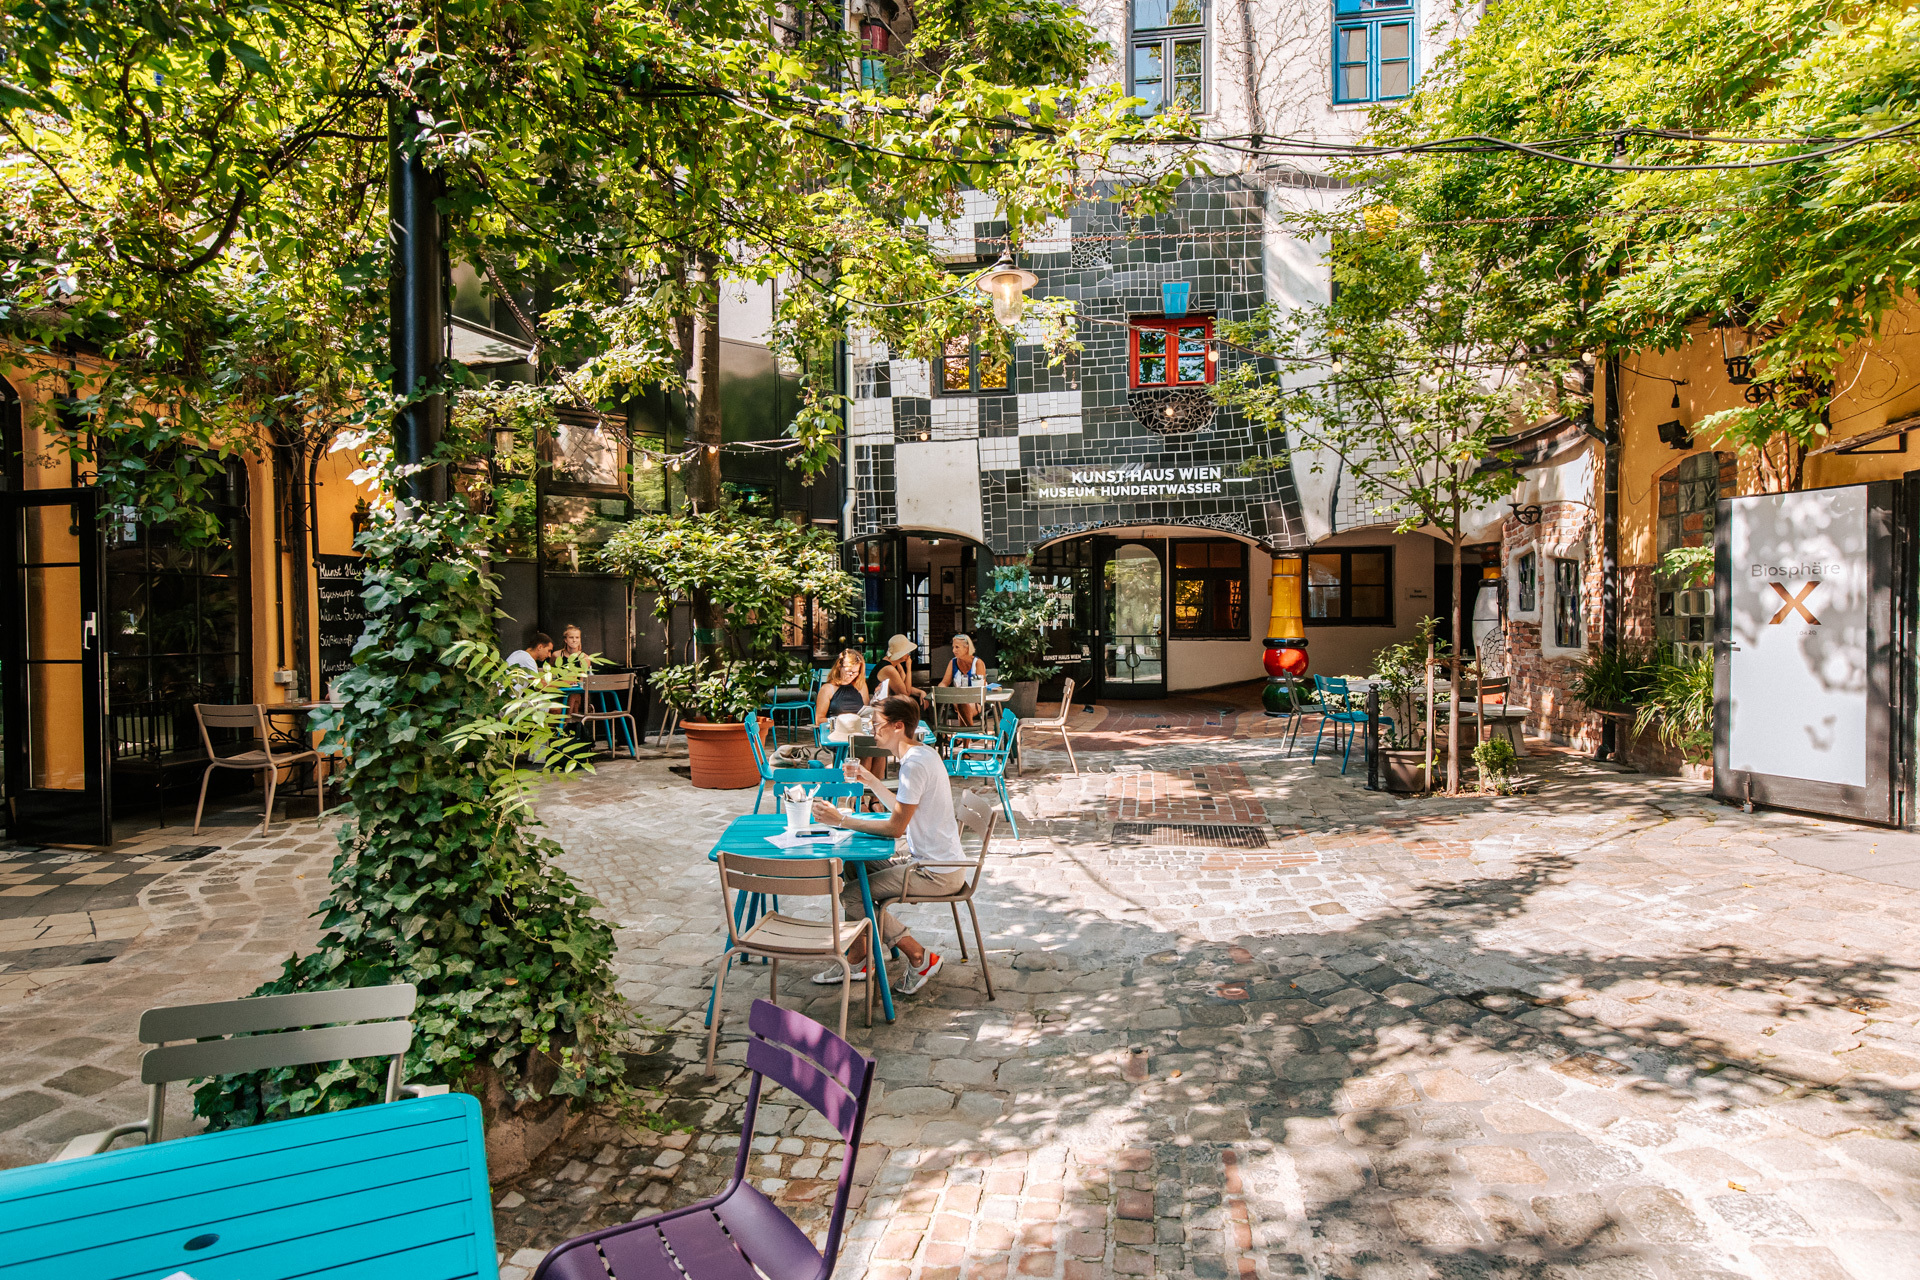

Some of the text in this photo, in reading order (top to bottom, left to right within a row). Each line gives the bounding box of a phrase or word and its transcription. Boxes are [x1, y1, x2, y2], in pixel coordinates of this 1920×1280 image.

[1072, 467, 1221, 484] KUNST HAUS WIEN
[1039, 483, 1222, 498] MUSEUM HUNDERTWASSER
[1751, 562, 1841, 579] Biosphäre
[1768, 580, 1822, 625] X
